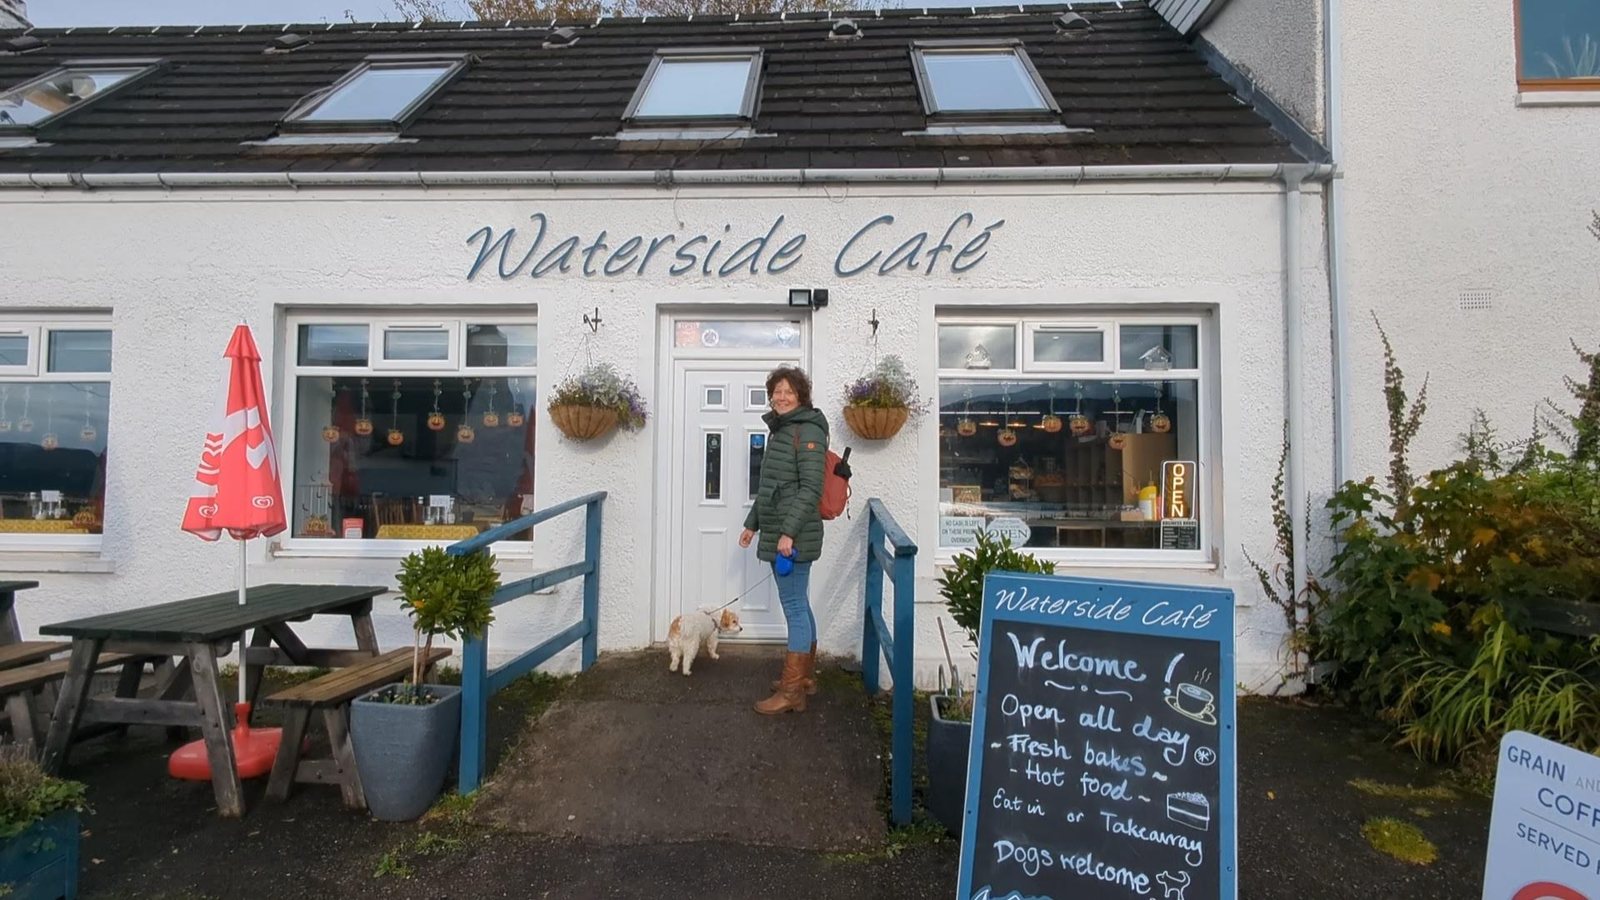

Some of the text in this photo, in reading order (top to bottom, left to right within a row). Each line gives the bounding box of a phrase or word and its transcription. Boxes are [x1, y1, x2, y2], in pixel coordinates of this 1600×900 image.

[465, 212, 1005, 281] Waterside Café
[1171, 463, 1185, 518] OPEN
[989, 529, 1028, 539] OPEN
[995, 587, 1218, 629] Waterside Café
[1007, 632, 1147, 682] Welcome
[1001, 693, 1190, 767] Open all day
[1006, 733, 1147, 777] Fresh bakes
[1507, 745, 1566, 783] GRAIN
[1025, 759, 1132, 801] Hot food
[993, 788, 1203, 867] Eat in or Takeaway
[1537, 787, 1600, 828] COFF
[993, 839, 1152, 895] Dogs welcome
[1516, 822, 1591, 869] SERVED
